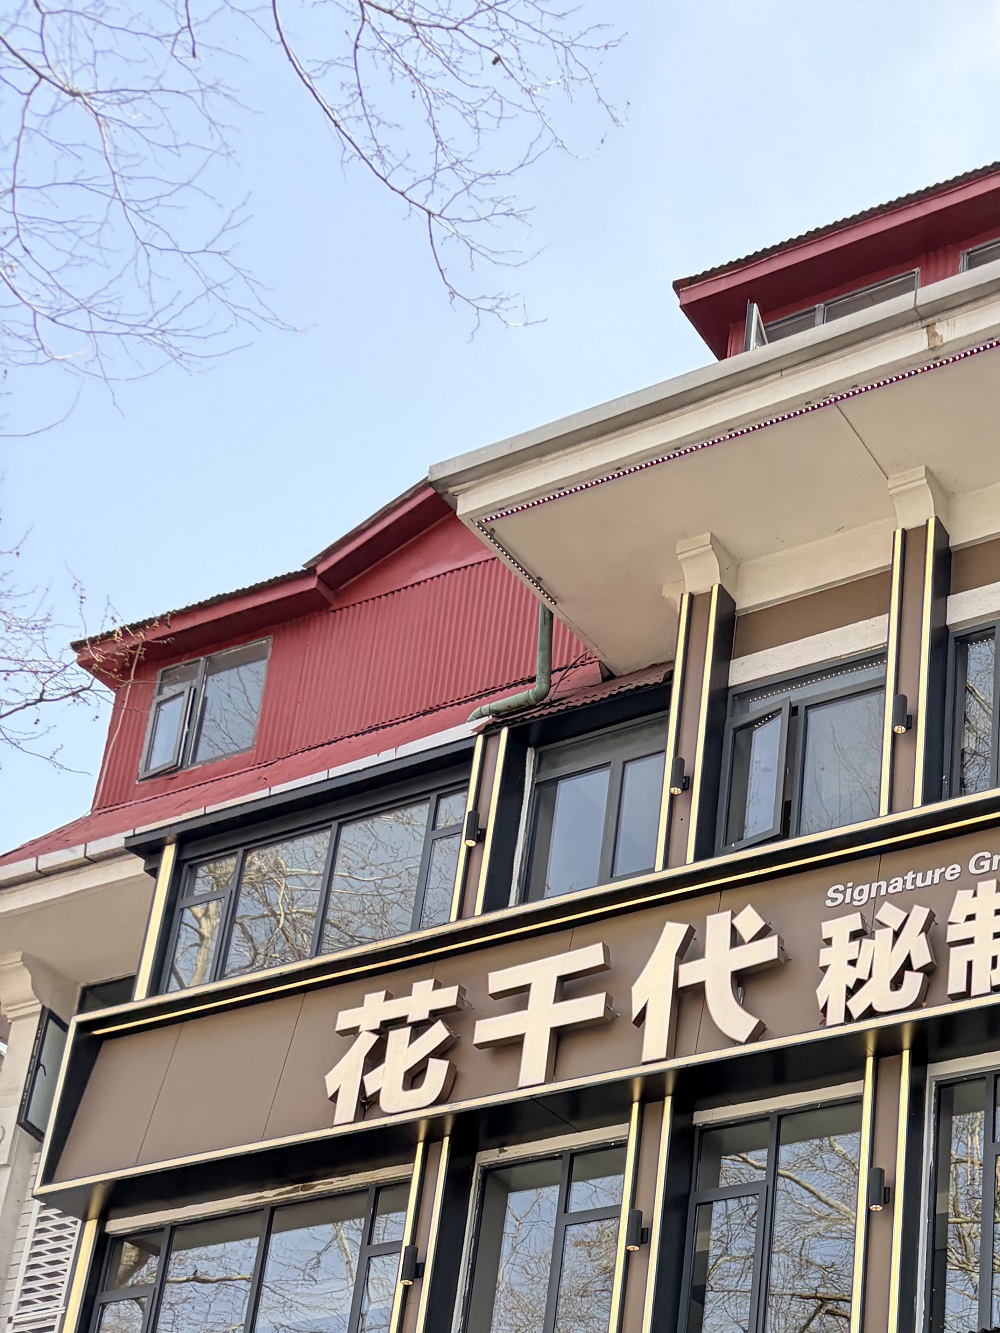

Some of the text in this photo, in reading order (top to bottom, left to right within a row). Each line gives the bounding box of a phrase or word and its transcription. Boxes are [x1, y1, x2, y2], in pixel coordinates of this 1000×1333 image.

[824, 860, 962, 908] Signature
[324, 903, 788, 1125] 花千代
